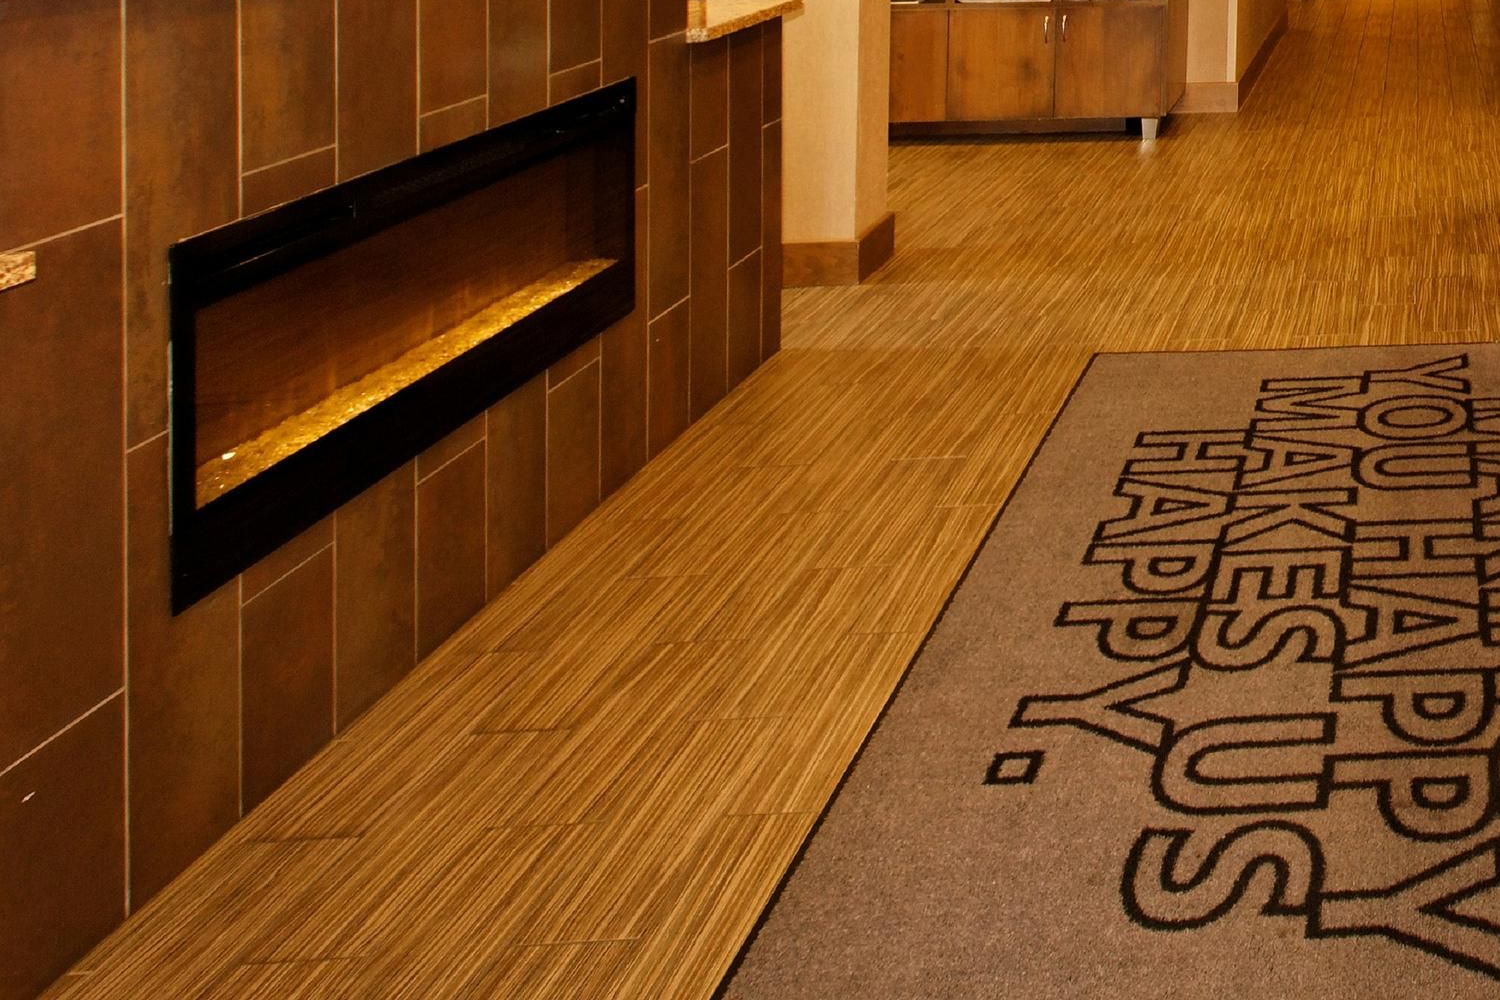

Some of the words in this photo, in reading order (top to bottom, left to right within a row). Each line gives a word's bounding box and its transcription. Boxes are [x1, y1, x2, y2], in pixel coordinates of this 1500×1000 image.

[1194, 374, 1371, 674] MAKES
[1350, 352, 1479, 491] YOU
[981, 428, 1254, 786] HAPPY.
[1119, 711, 1337, 933] US
